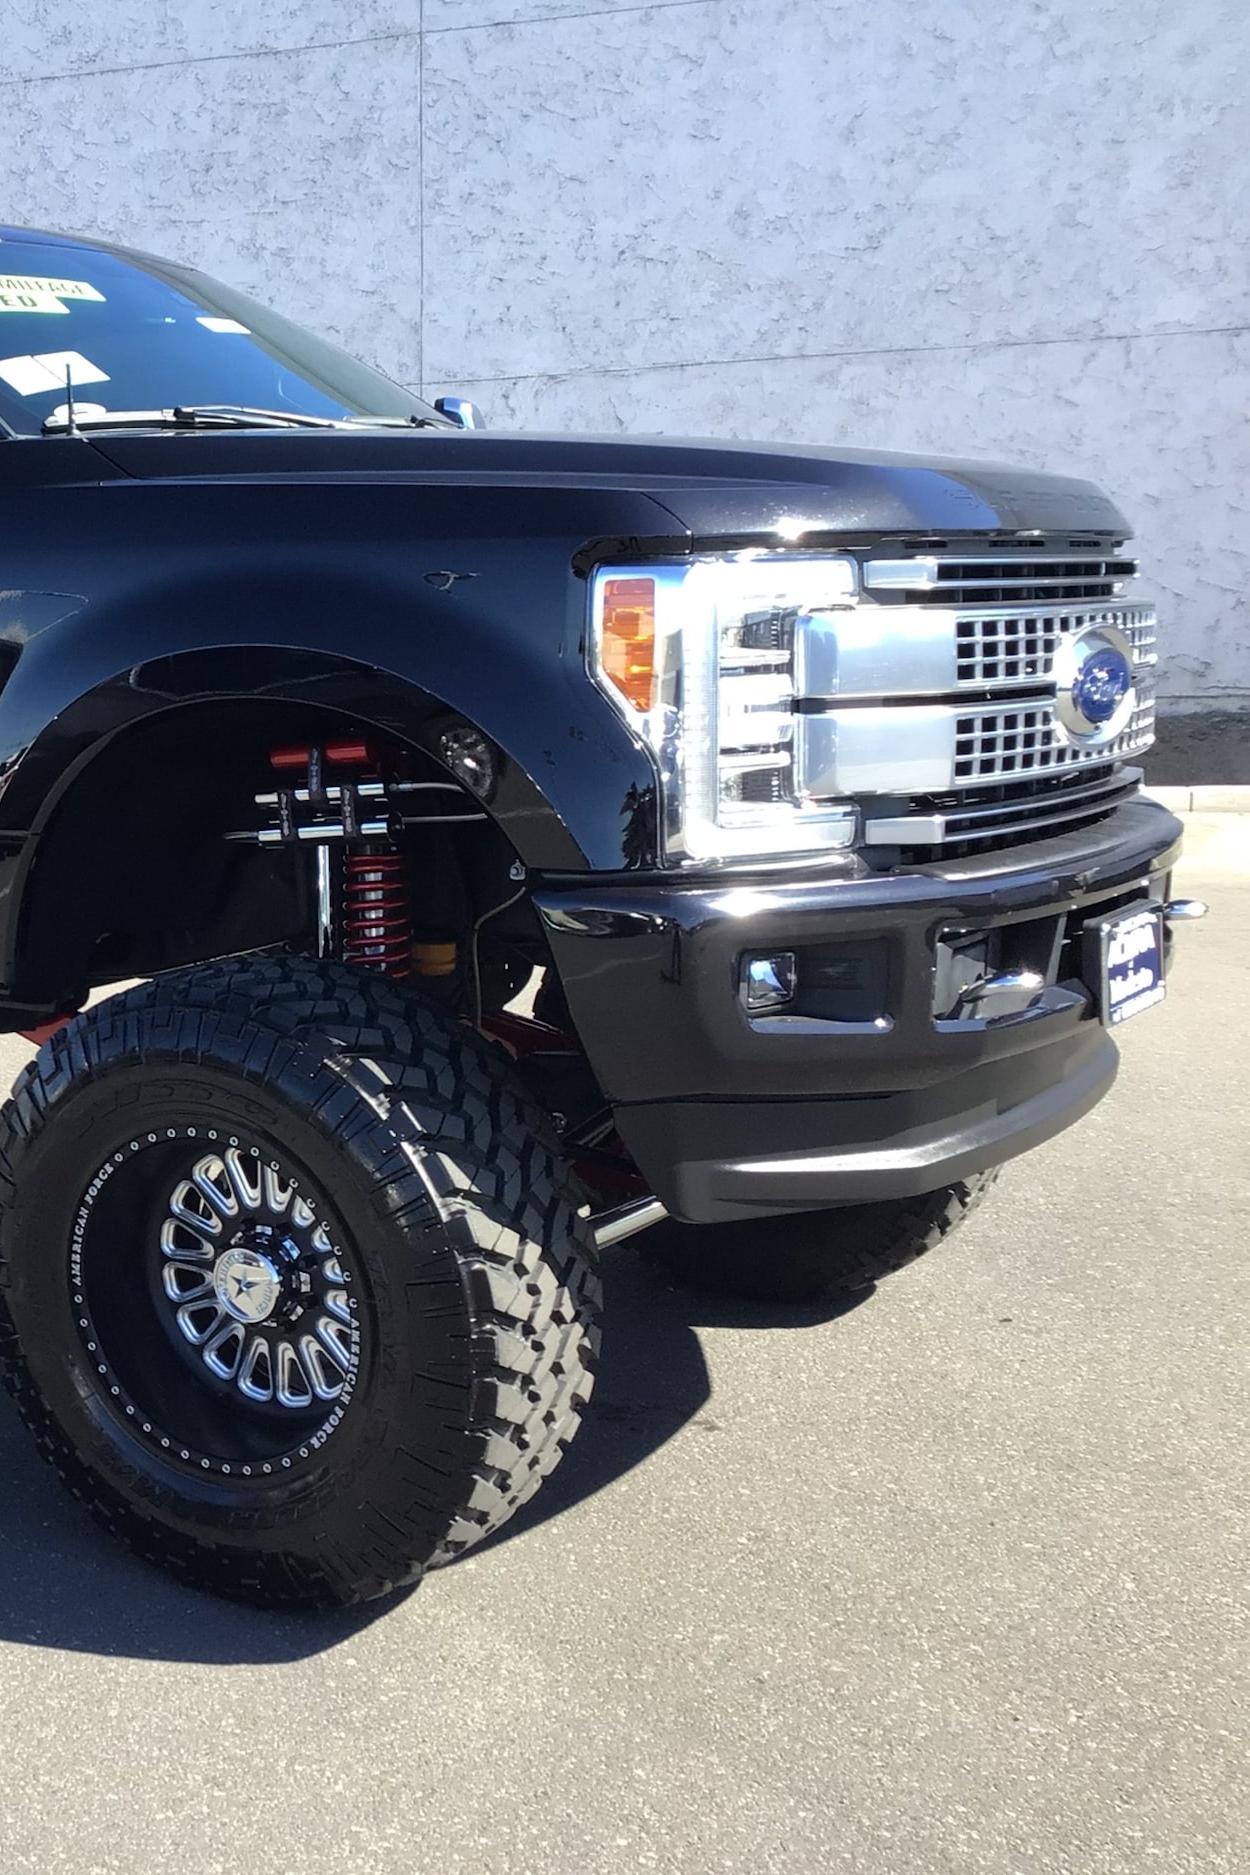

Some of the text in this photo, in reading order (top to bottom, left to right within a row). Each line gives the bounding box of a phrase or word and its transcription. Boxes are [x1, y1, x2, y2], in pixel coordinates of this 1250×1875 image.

[70, 1161, 115, 1287] AMERICAN FORCE
[310, 1318, 361, 1450] AMERICAN FORCE
